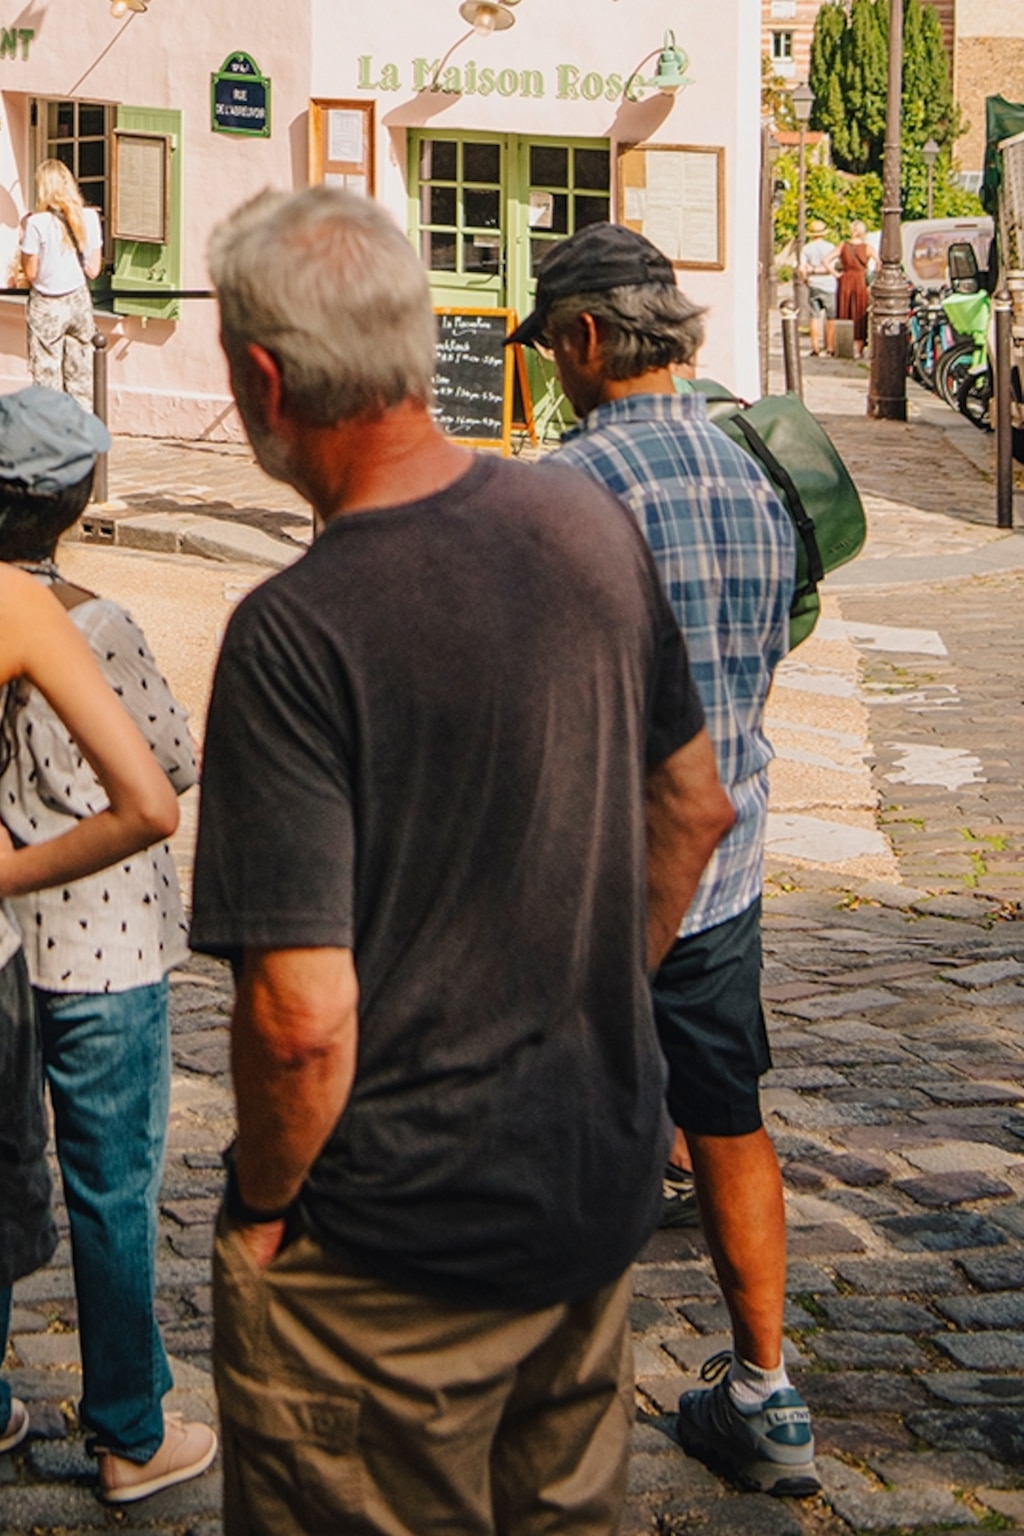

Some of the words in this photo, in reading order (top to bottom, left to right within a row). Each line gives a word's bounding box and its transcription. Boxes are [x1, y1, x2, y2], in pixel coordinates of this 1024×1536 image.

[357, 55, 401, 91] La
[411, 58, 544, 97] Maison
[555, 64, 646, 102] Rose
[232, 88, 248, 101] RUE
